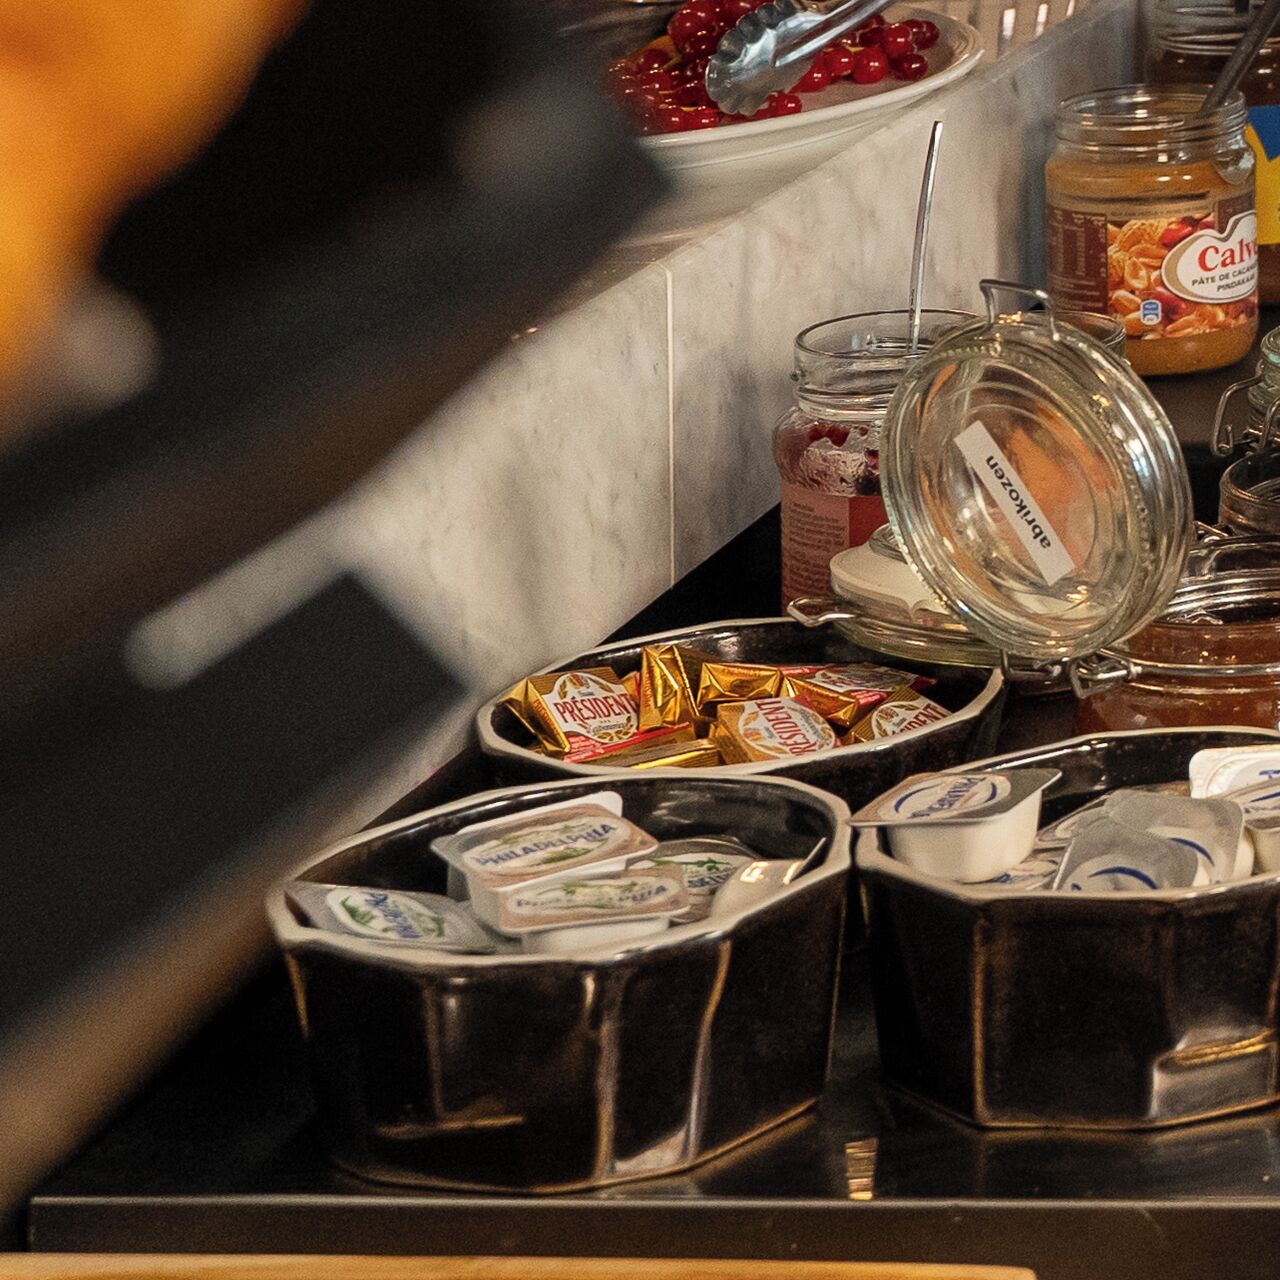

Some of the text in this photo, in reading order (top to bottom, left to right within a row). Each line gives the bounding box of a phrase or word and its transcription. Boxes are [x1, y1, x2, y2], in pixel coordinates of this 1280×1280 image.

[1197, 238, 1258, 273] Calv
[1191, 275, 1216, 286] PÂTE
[1218, 272, 1230, 281] DE
[985, 455, 1053, 550] abrikozen
[553, 693, 637, 724] PRÉSIDENT
[755, 698, 816, 757] RÉSIDENT
